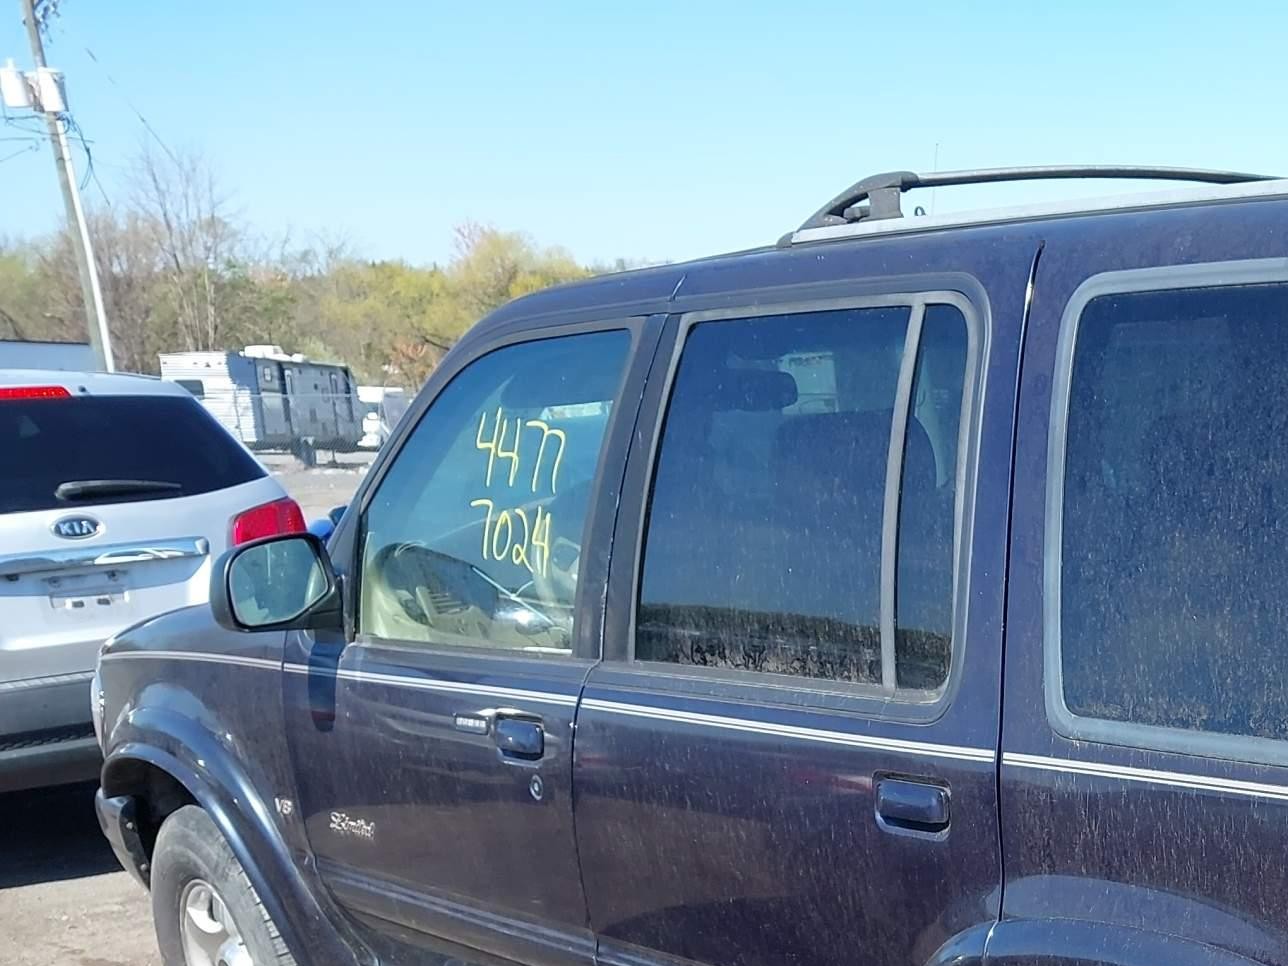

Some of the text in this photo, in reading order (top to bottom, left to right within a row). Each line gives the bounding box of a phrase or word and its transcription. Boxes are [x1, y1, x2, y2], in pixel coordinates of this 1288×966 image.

[476, 406, 566, 494] 4477
[58, 520, 95, 535] KIA
[470, 498, 551, 579] 7024
[329, 811, 375, 839] Limited
